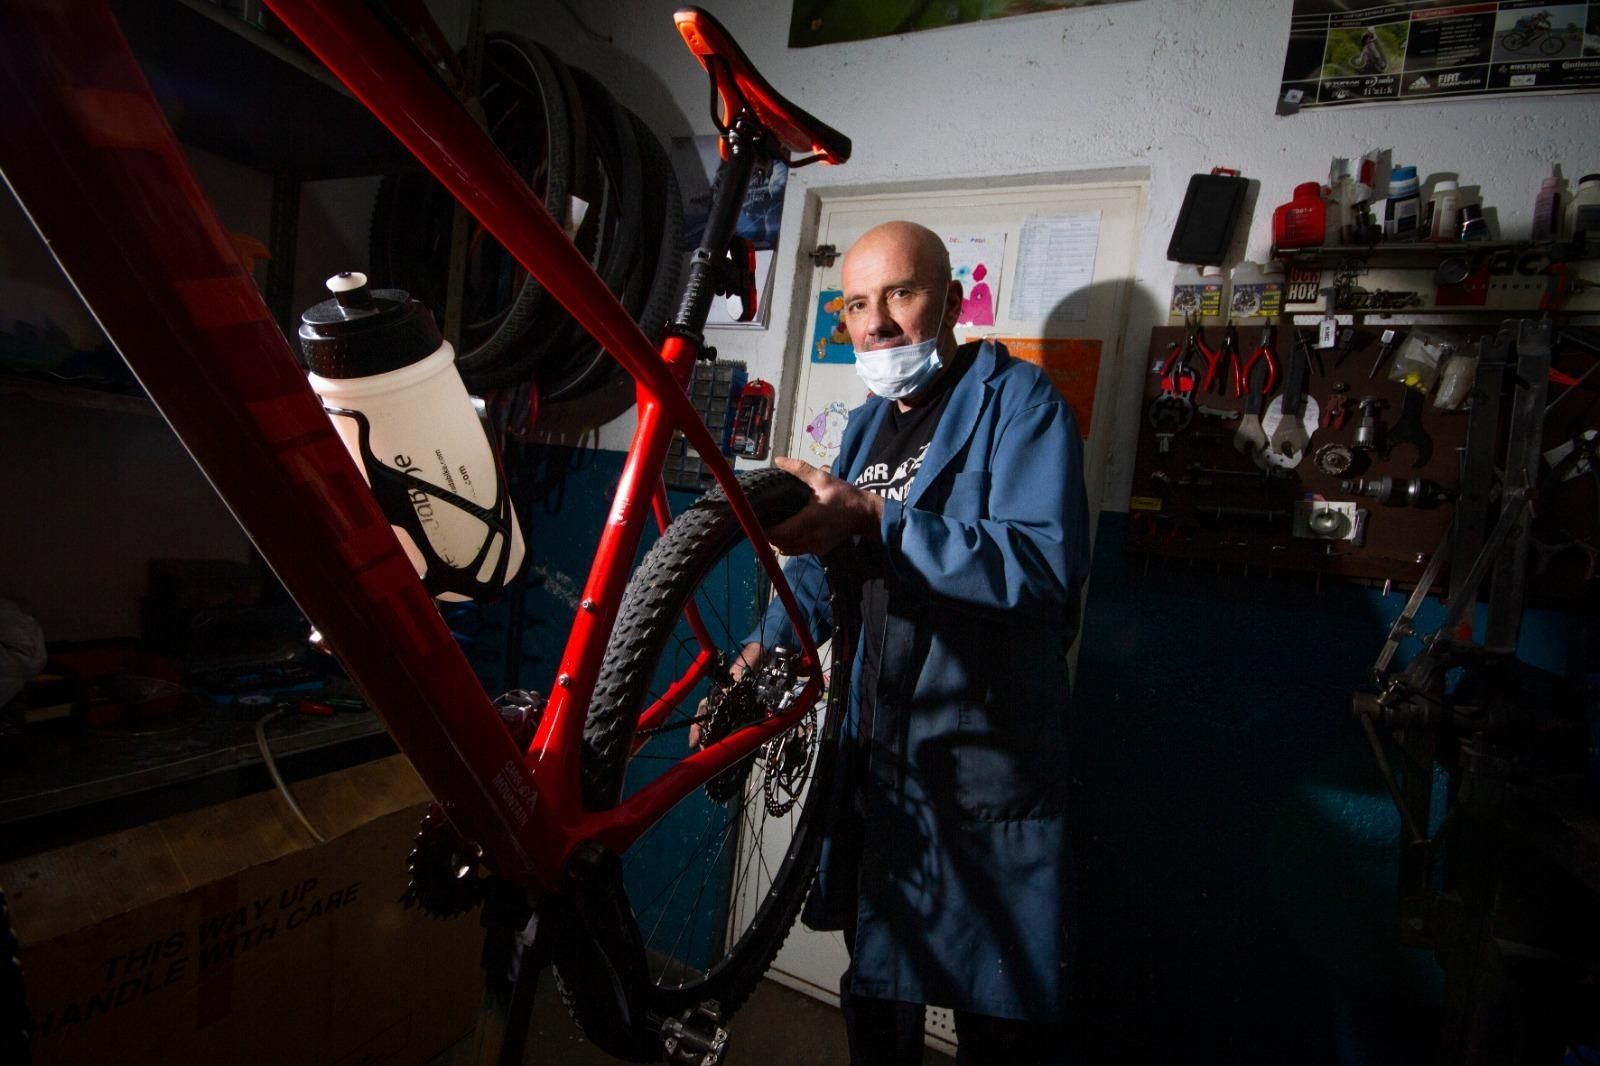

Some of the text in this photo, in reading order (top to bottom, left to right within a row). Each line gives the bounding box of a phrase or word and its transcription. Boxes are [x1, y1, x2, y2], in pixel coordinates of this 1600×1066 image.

[104, 877, 319, 981] THIS WAY UP
[201, 916, 279, 968] WITH
[286, 882, 361, 930] CARE
